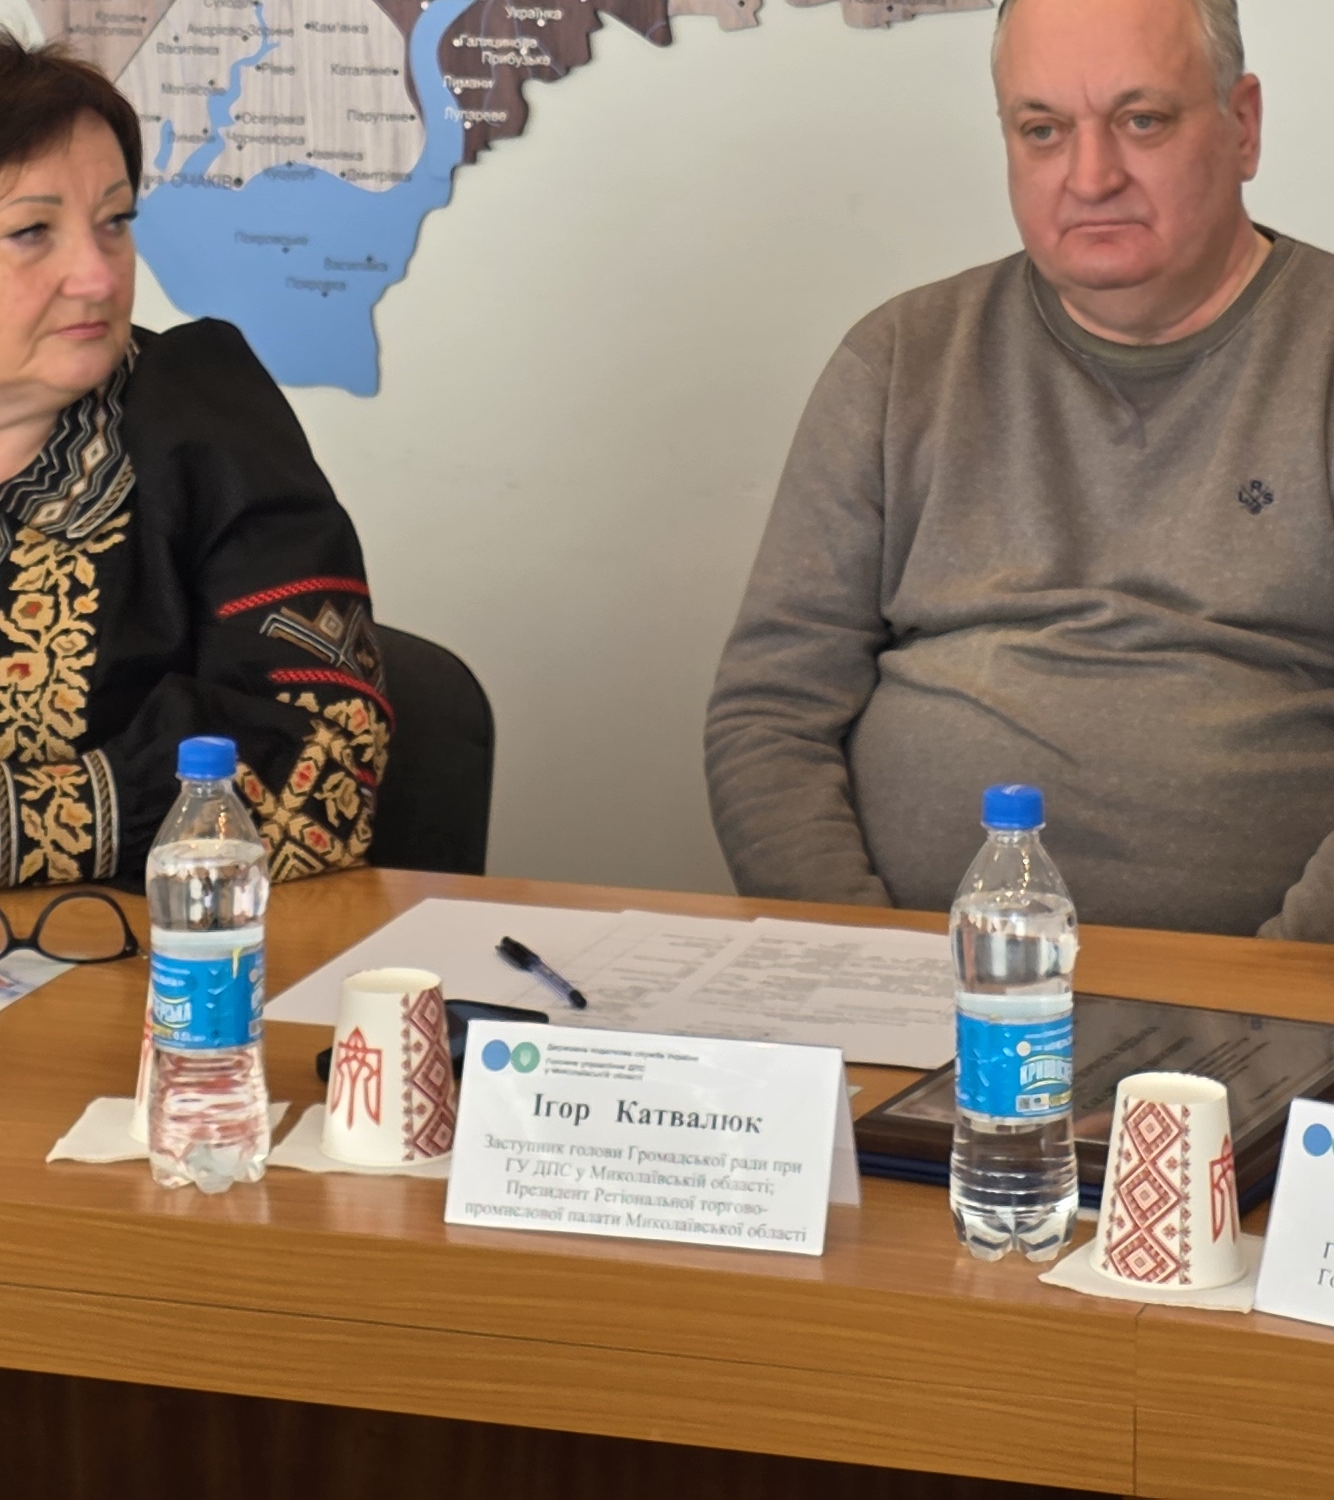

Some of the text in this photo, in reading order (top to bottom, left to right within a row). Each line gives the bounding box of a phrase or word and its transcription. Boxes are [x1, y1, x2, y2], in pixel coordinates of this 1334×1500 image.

[171, 175, 236, 189] ОЧАКІВ
[533, 1093, 763, 1133] Ігор Катвалюк
[484, 1134, 803, 1175] Заступник голови Громадської ради при
[505, 1158, 529, 1173] ГУ
[533, 1160, 572, 1178] ДПС
[575, 1170, 584, 1181] у
[506, 1181, 589, 1202] Президент
